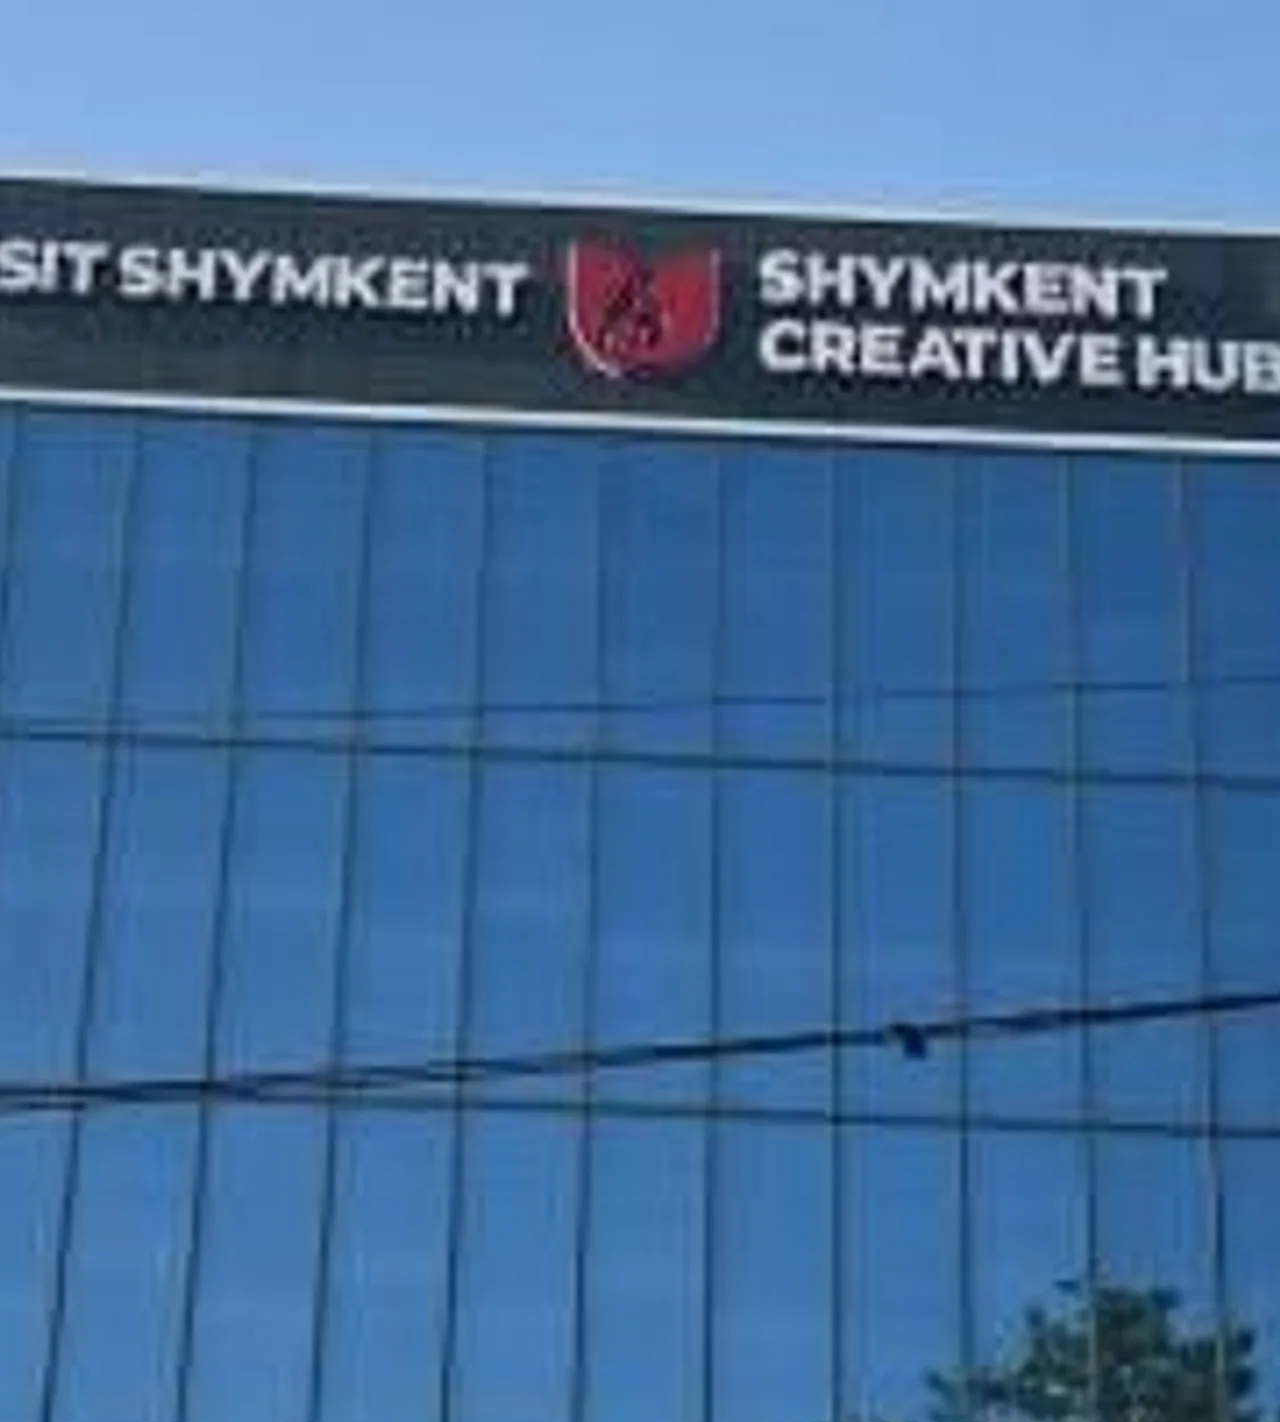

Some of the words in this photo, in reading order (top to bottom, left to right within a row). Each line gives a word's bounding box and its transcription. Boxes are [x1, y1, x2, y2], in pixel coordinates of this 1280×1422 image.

[118, 245, 531, 316] SHYMKENT
[758, 248, 1169, 319] SHYMKENT
[758, 317, 1124, 386] CREATIVE
